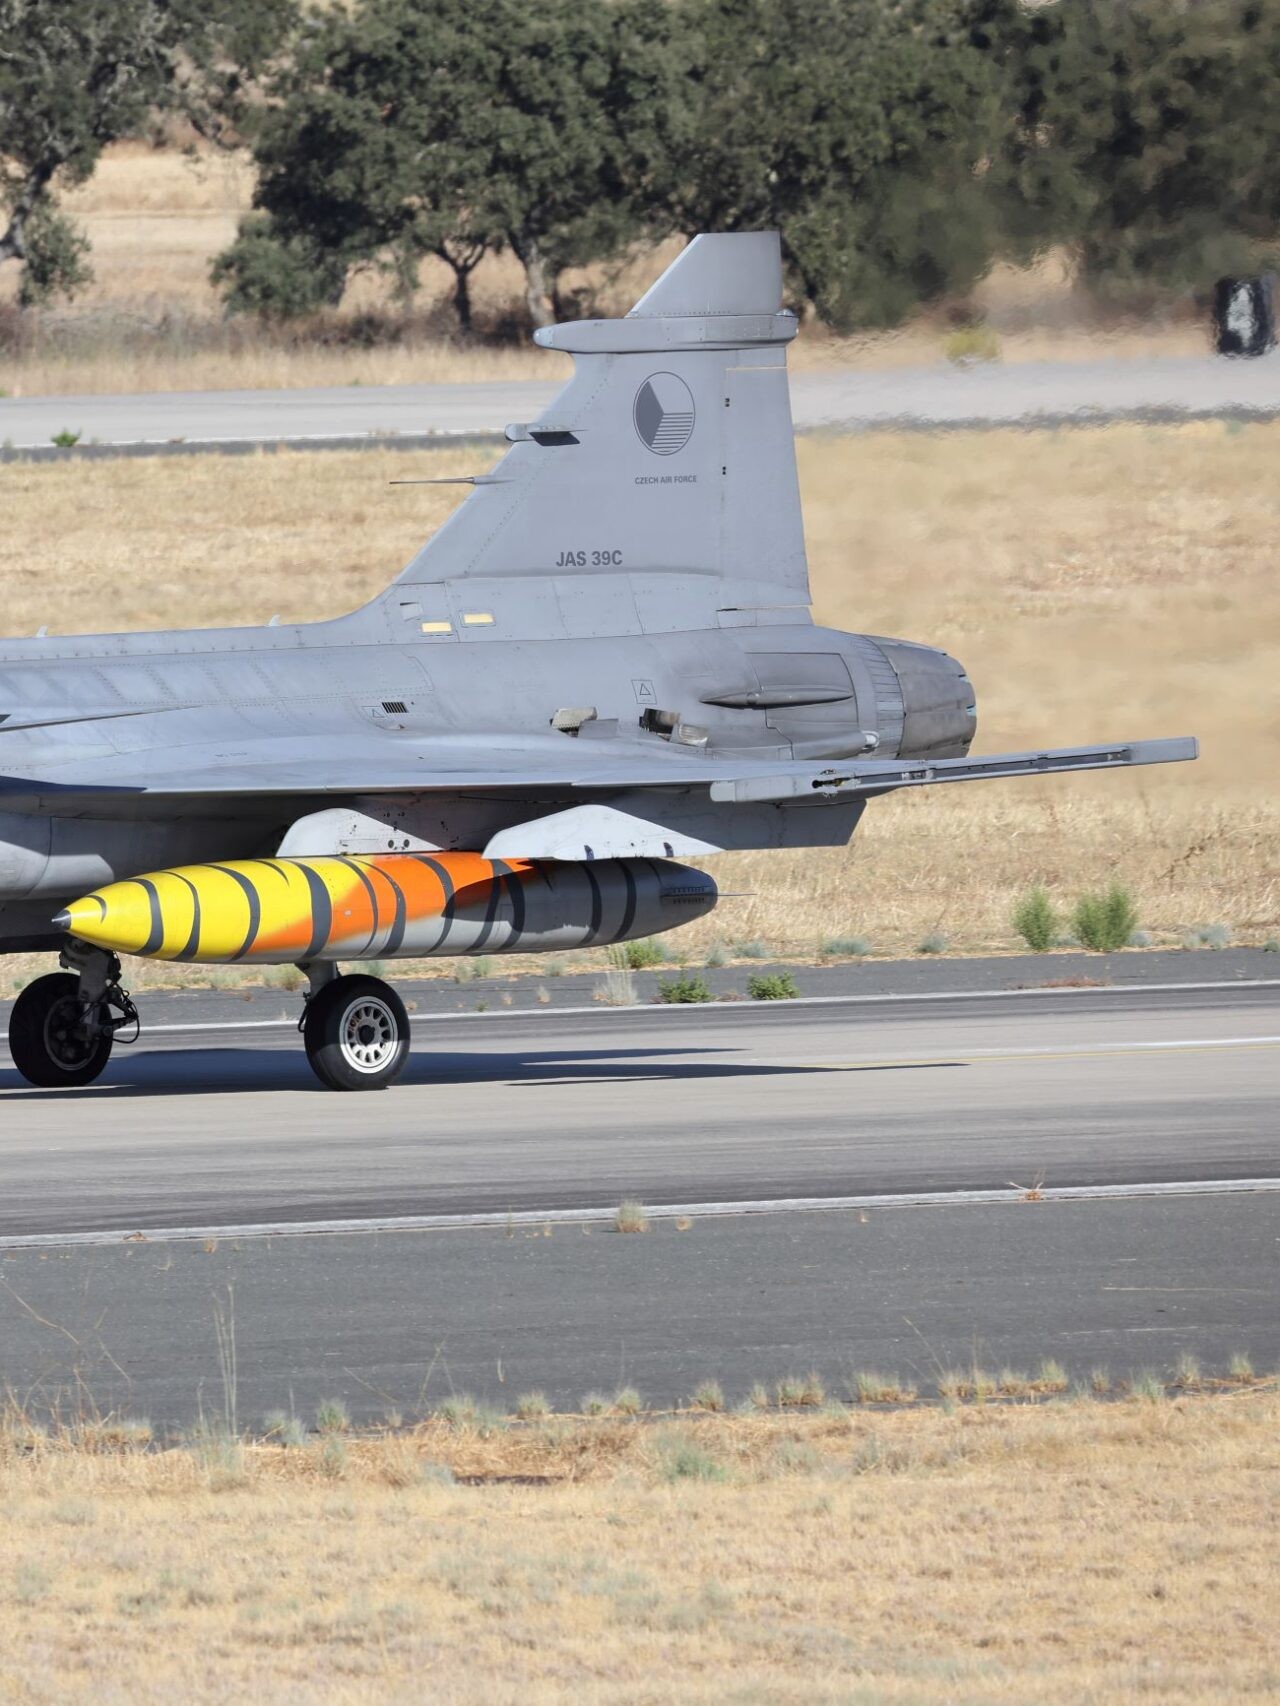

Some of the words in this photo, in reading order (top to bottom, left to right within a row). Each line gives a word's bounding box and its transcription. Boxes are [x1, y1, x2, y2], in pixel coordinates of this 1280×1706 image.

[634, 475, 659, 485] CZECH
[660, 475, 673, 484] AIR
[673, 474, 697, 483] FORCE
[555, 551, 587, 567] JAS
[591, 549, 623, 566] 39C
